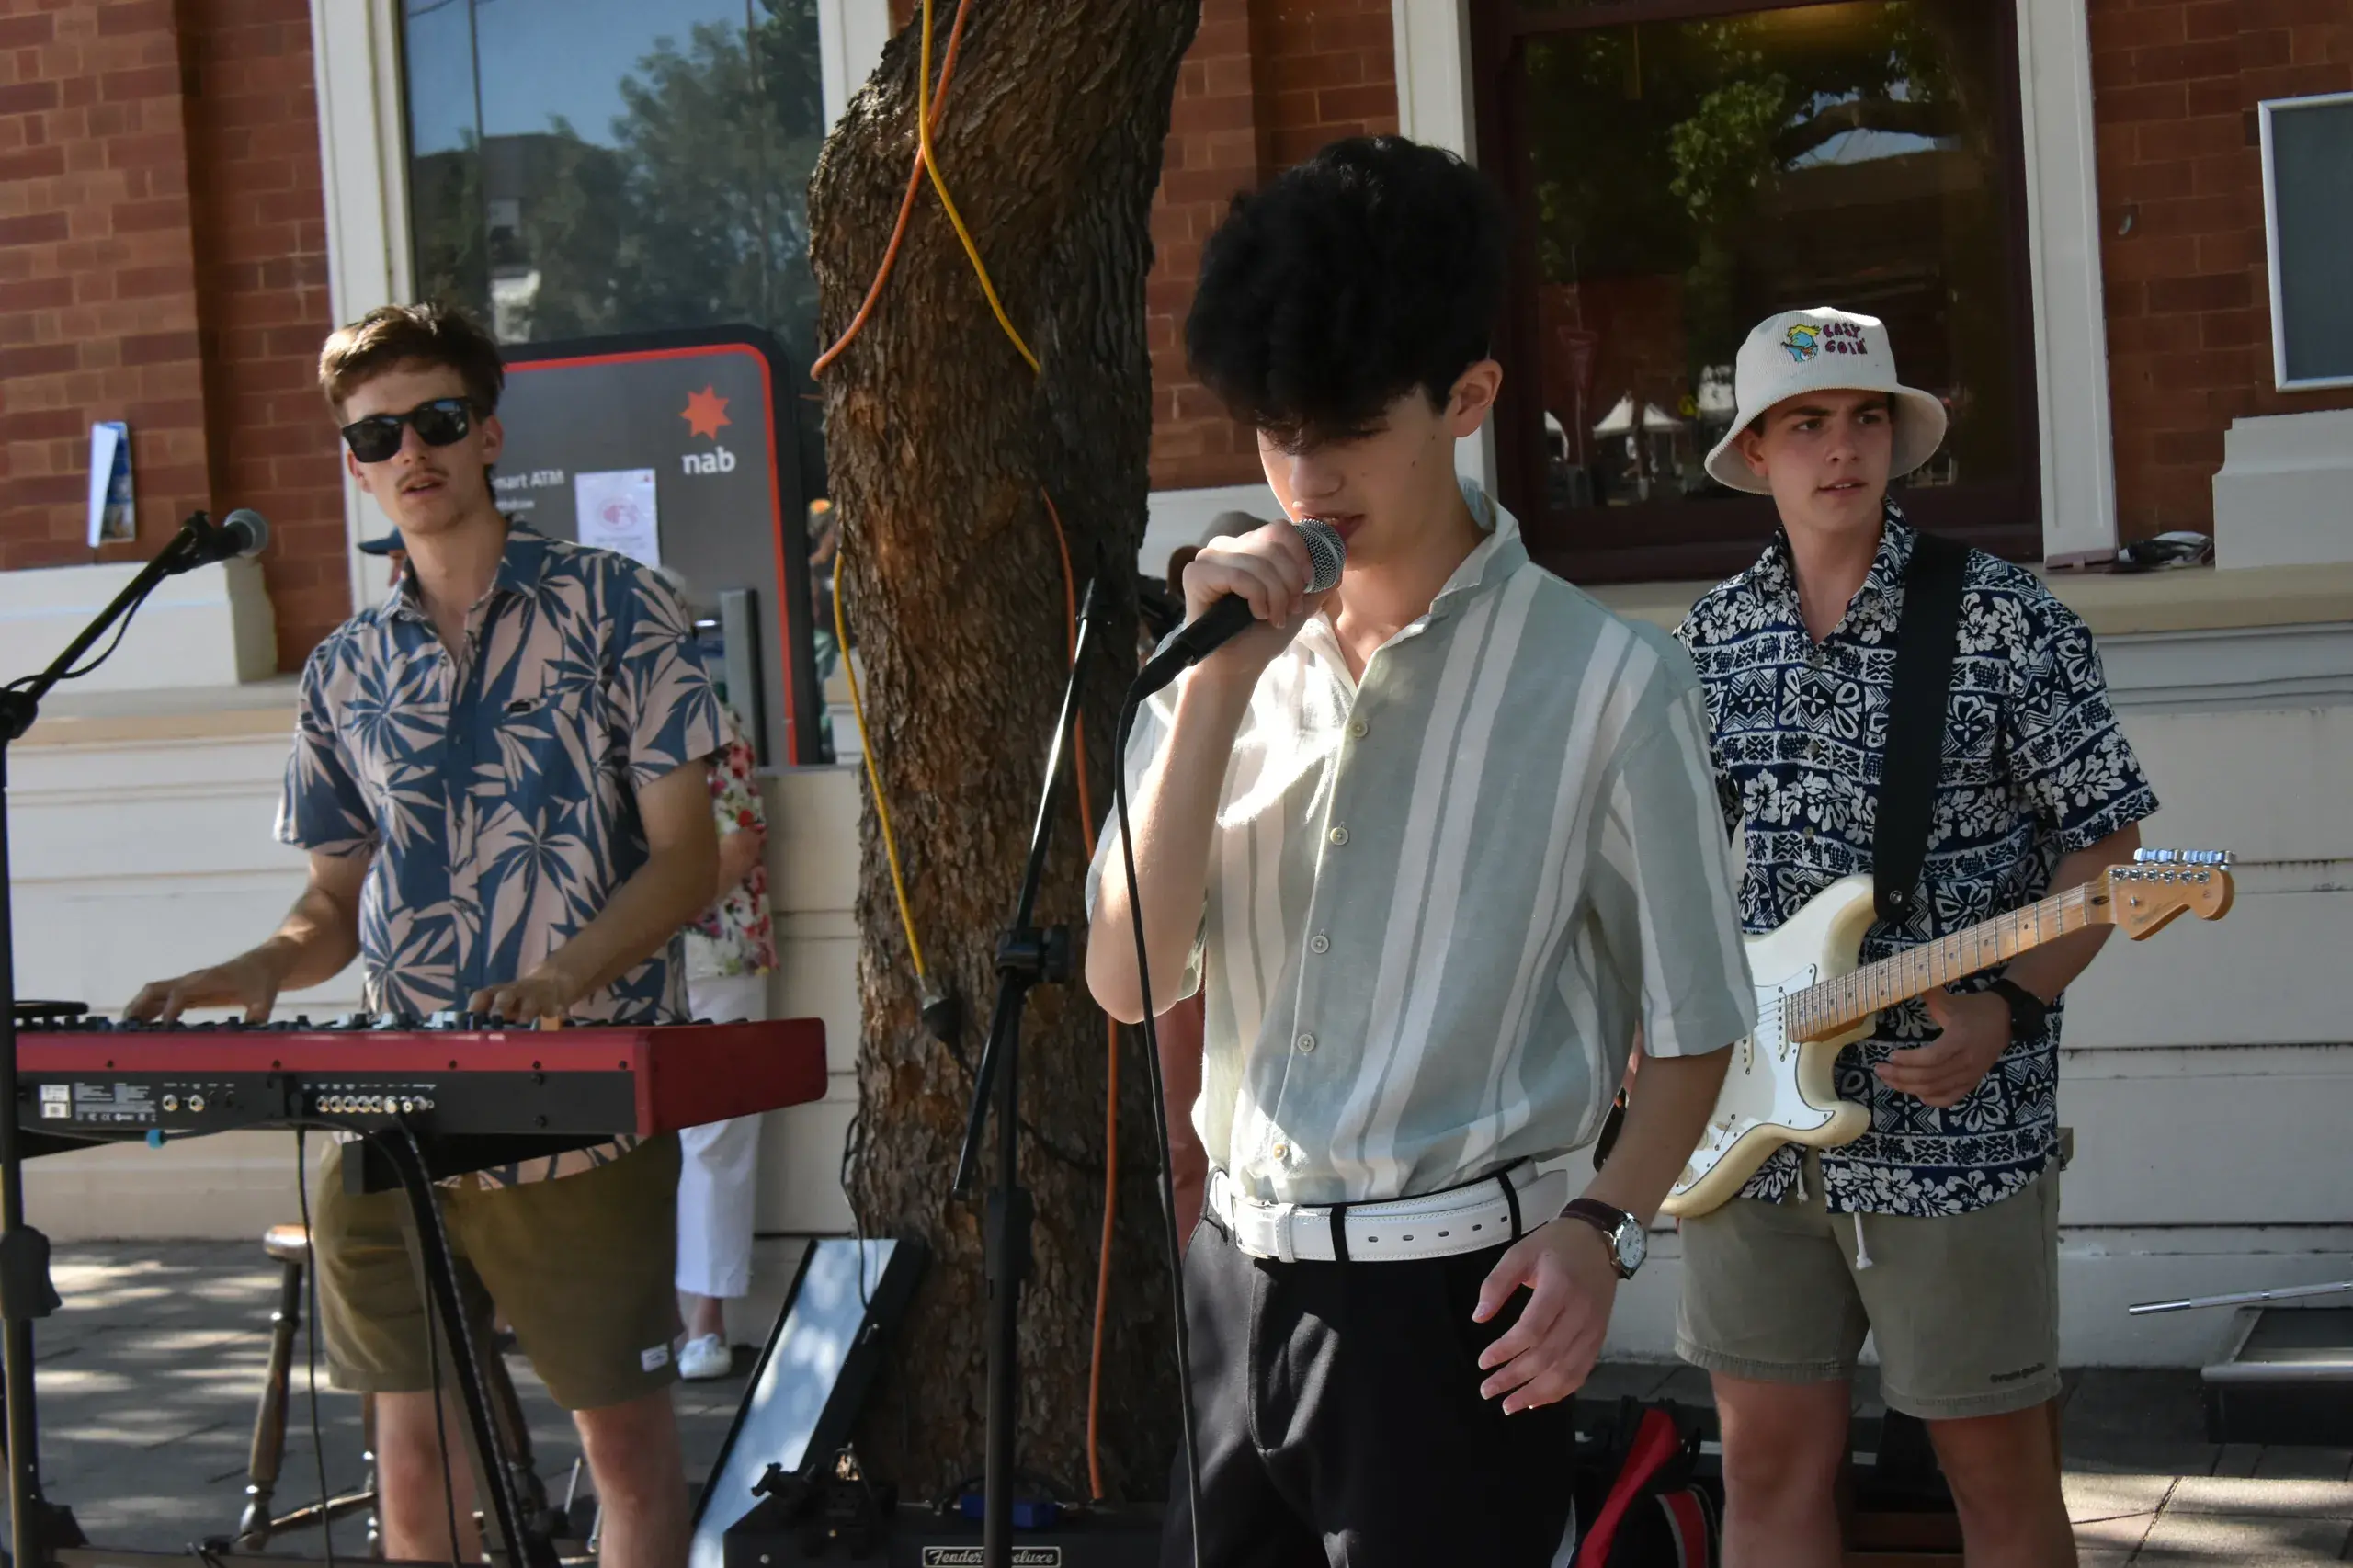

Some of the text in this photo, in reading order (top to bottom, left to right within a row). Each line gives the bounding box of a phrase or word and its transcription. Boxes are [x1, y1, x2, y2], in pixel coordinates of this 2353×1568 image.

[1823, 323, 1861, 338] EASY
[681, 445, 737, 475] nab
[491, 468, 564, 490] mart ATM
[928, 1548, 1055, 1565] Fender eluxe
